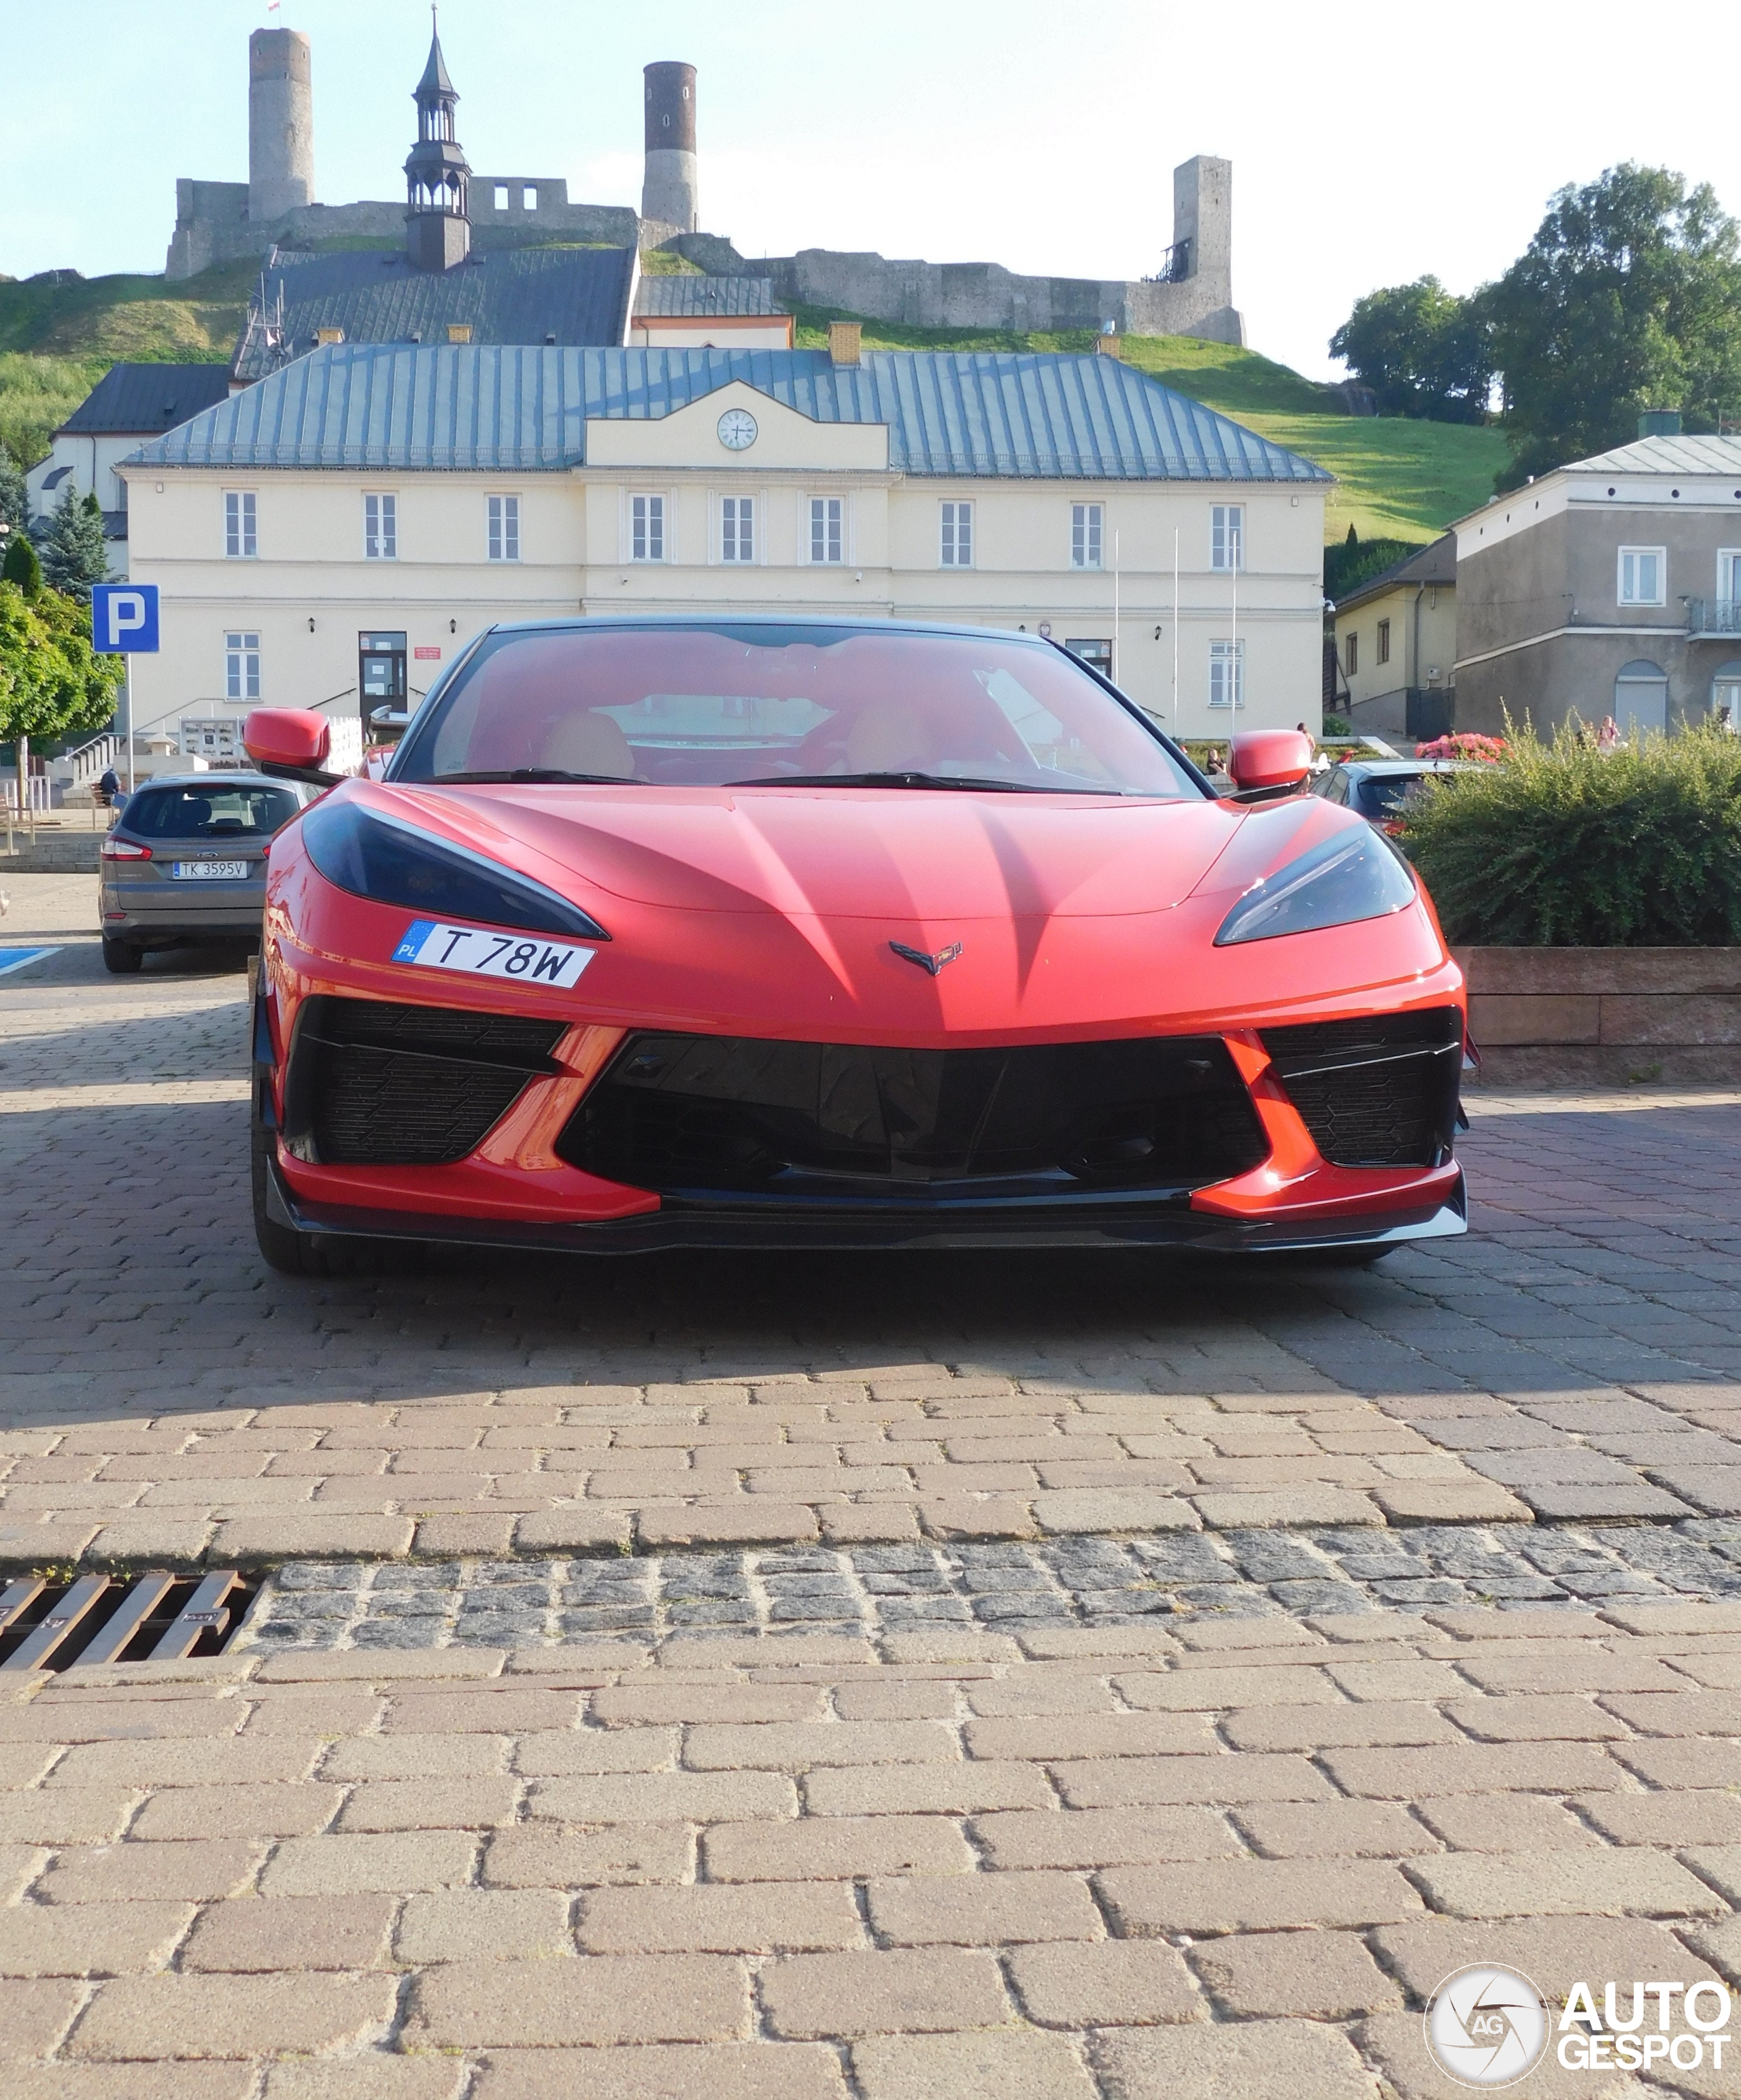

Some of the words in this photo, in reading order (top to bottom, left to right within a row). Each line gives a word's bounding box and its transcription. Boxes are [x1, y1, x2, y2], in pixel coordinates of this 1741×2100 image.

[108, 592, 145, 645] P
[182, 863, 198, 875] TK
[203, 862, 242, 875] 3595V
[397, 944, 416, 958] PL
[439, 930, 473, 964] T
[475, 937, 575, 981] 78W
